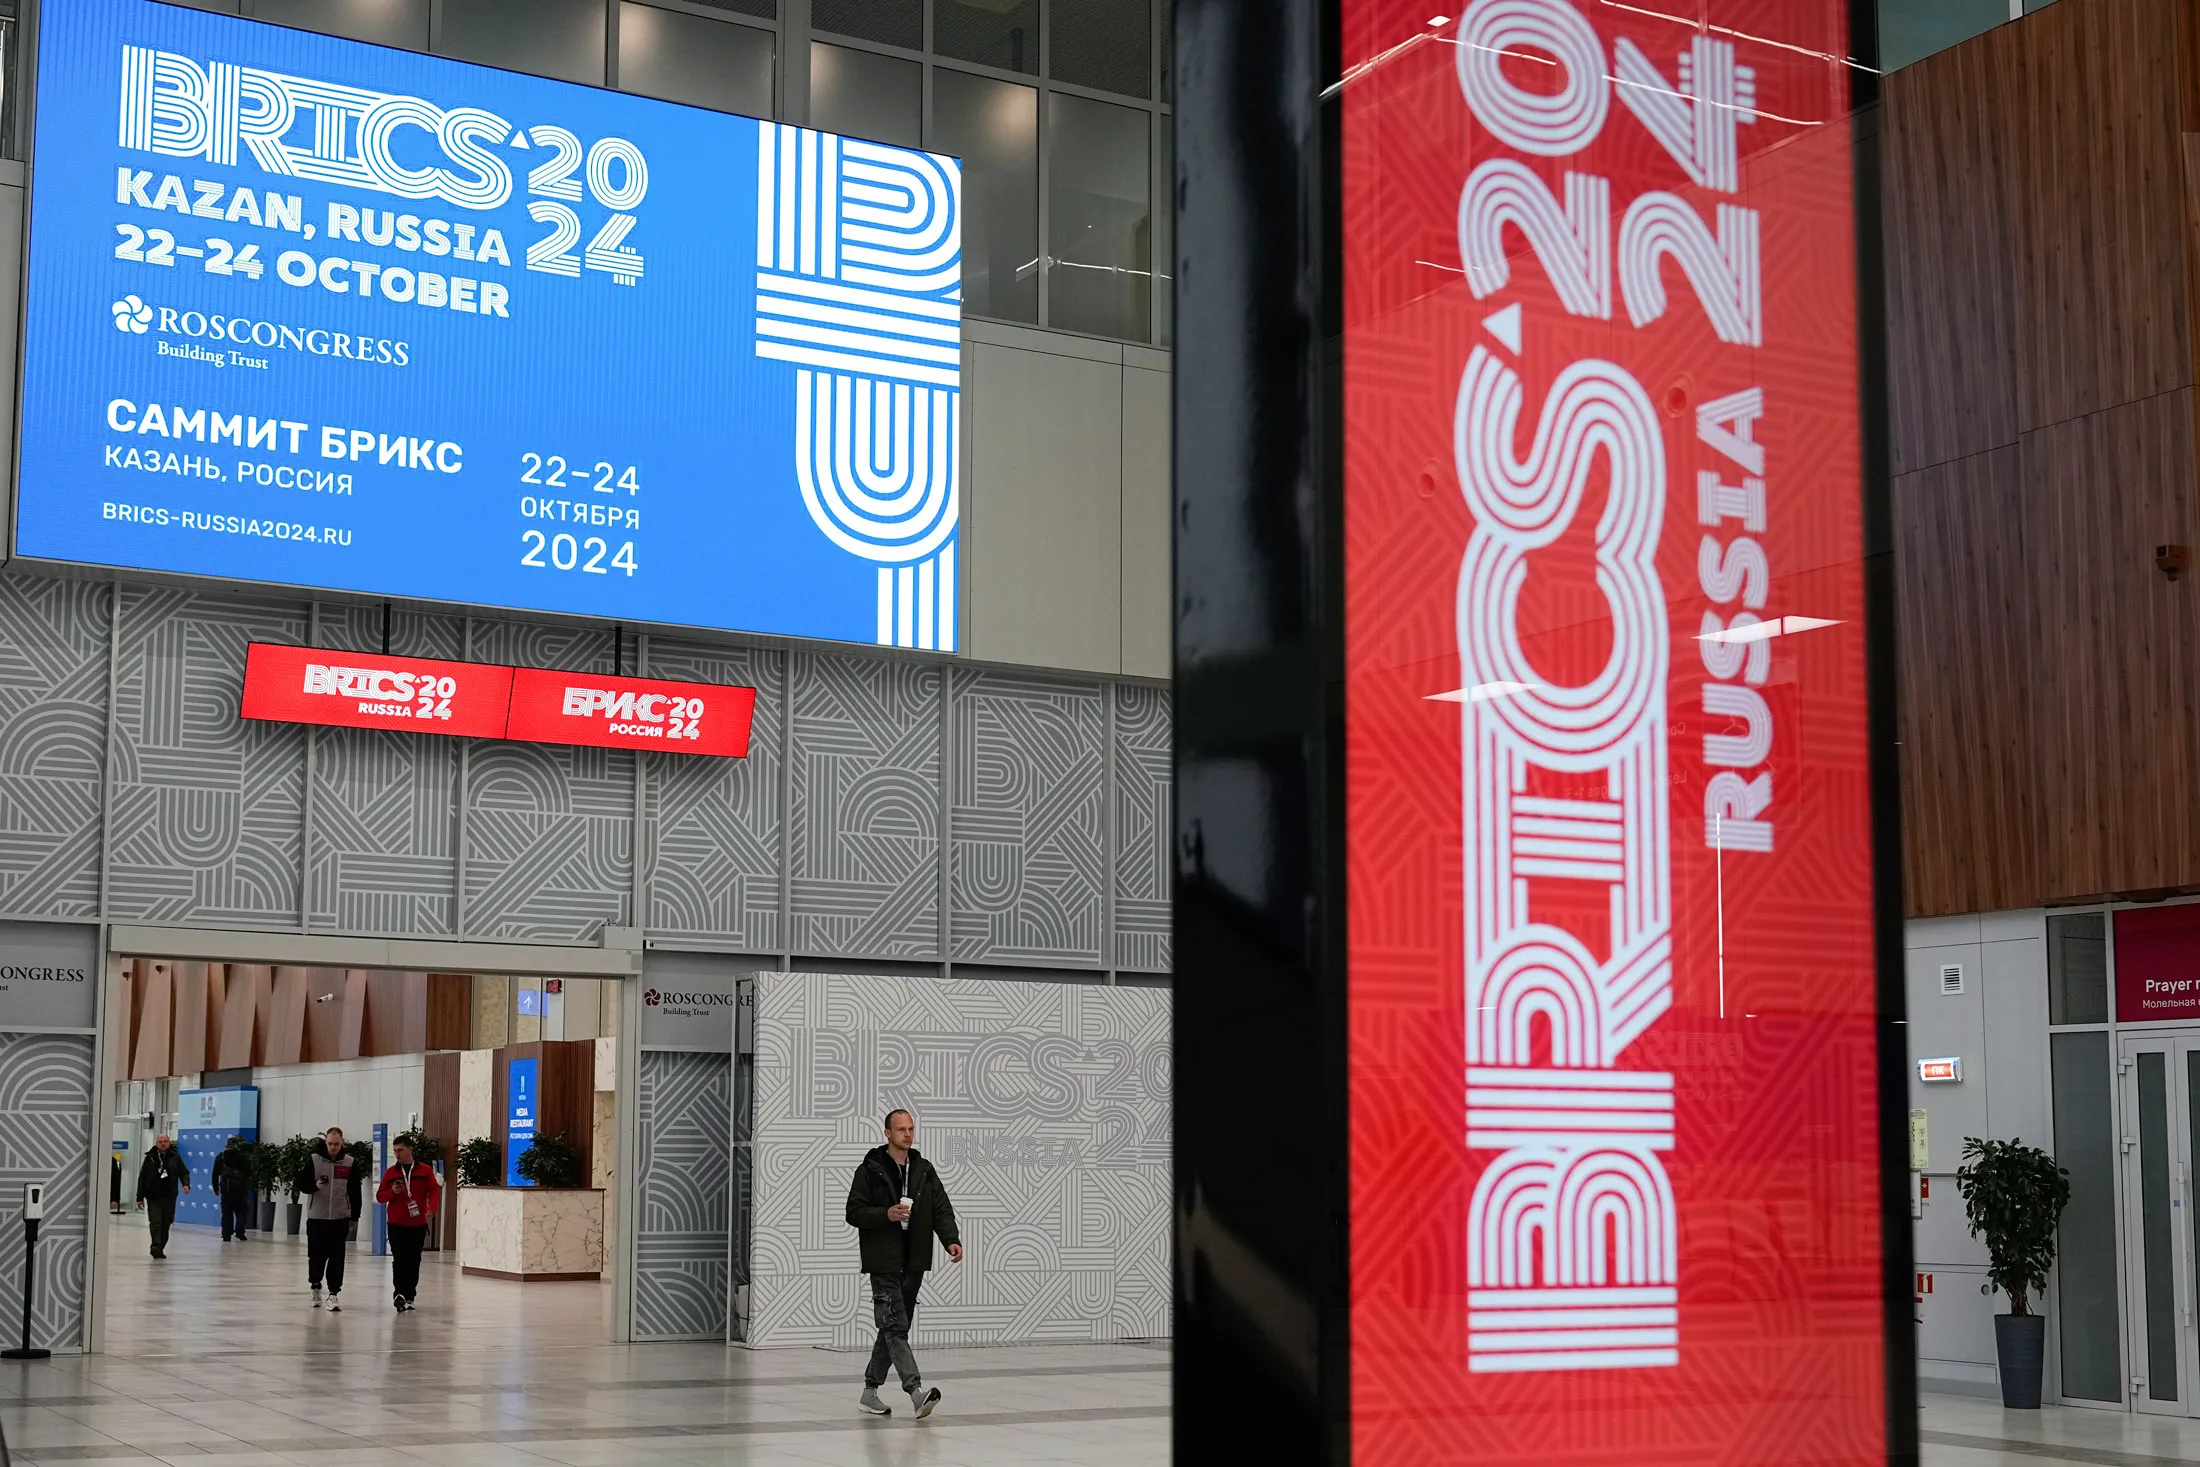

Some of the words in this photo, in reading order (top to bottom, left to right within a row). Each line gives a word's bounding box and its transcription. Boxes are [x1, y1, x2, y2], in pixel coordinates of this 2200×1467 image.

[119, 44, 513, 211] BRICS
[527, 124, 649, 211] 20
[1456, 0, 1612, 321] 20
[1614, 34, 1762, 347] 24
[117, 167, 317, 241] KAZAN,
[327, 202, 511, 267] RUSSIA
[526, 200, 644, 287] 24
[276, 250, 510, 318] OCTOBER
[157, 306, 409, 366] ROSCONGRESS
[157, 340, 225, 367] Building
[227, 350, 269, 370] Trust
[107, 398, 309, 454] САММИТ
[320, 426, 463, 474] БРИКС
[105, 445, 227, 483] КАЗАНЬ,
[237, 462, 353, 496] РОССИЯ
[103, 502, 352, 546] BRICS-RUSSIA2024.RU
[521, 496, 640, 530] ОКТЯБРЯ
[520, 529, 638, 577] 2024
[1696, 386, 1774, 853] RUSSIA
[303, 664, 416, 702] BRICS
[418, 675, 457, 699] 20
[358, 702, 412, 718] RUSSIA
[415, 697, 453, 721] 24
[562, 687, 668, 723] БРИКС
[669, 696, 705, 720] 20
[609, 723, 664, 738] РОССИЯ
[666, 717, 701, 740] 24
[1453, 344, 1678, 1372] BRICS
[0, 965, 85, 982] ONGRESS
[2145, 979, 2193, 995] Prayer
[662, 991, 754, 1007] ROSCONGRE
[662, 1007, 692, 1018] Building
[692, 1008, 710, 1017] Trust
[2142, 999, 2196, 1009] Молельная
[789, 1027, 1084, 1120] BRICS
[944, 1134, 1085, 1168] RUSSIA
